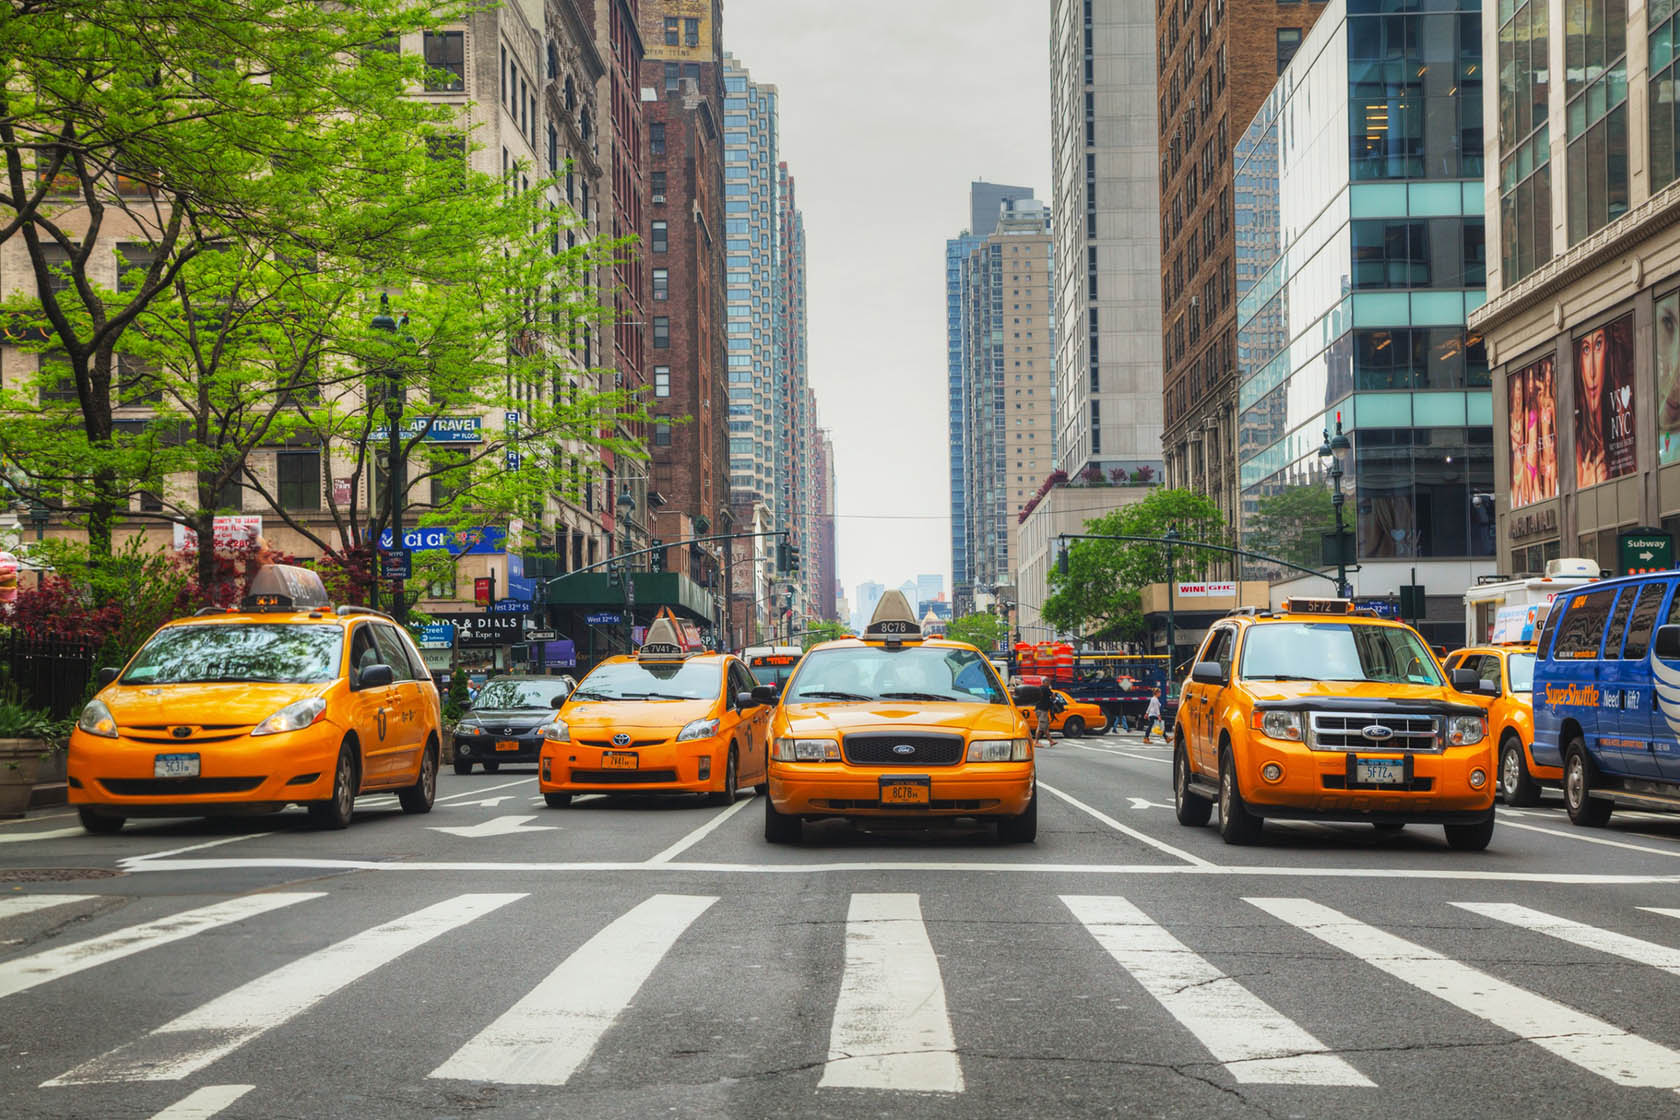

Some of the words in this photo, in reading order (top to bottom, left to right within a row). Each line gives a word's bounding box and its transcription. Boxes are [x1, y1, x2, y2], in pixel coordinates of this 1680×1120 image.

[432, 418, 476, 432] TRAVEL
[1611, 411, 1632, 440] NYC
[1627, 540, 1665, 549] Subway
[521, 603, 529, 611] St
[587, 616, 602, 624] West
[881, 622, 906, 633] 8C78
[475, 631, 501, 641] Expets
[651, 645, 670, 653] 7V41
[1545, 682, 1600, 711] SuperShuttle
[1603, 690, 1620, 708] Need
[1627, 689, 1640, 709] lift?
